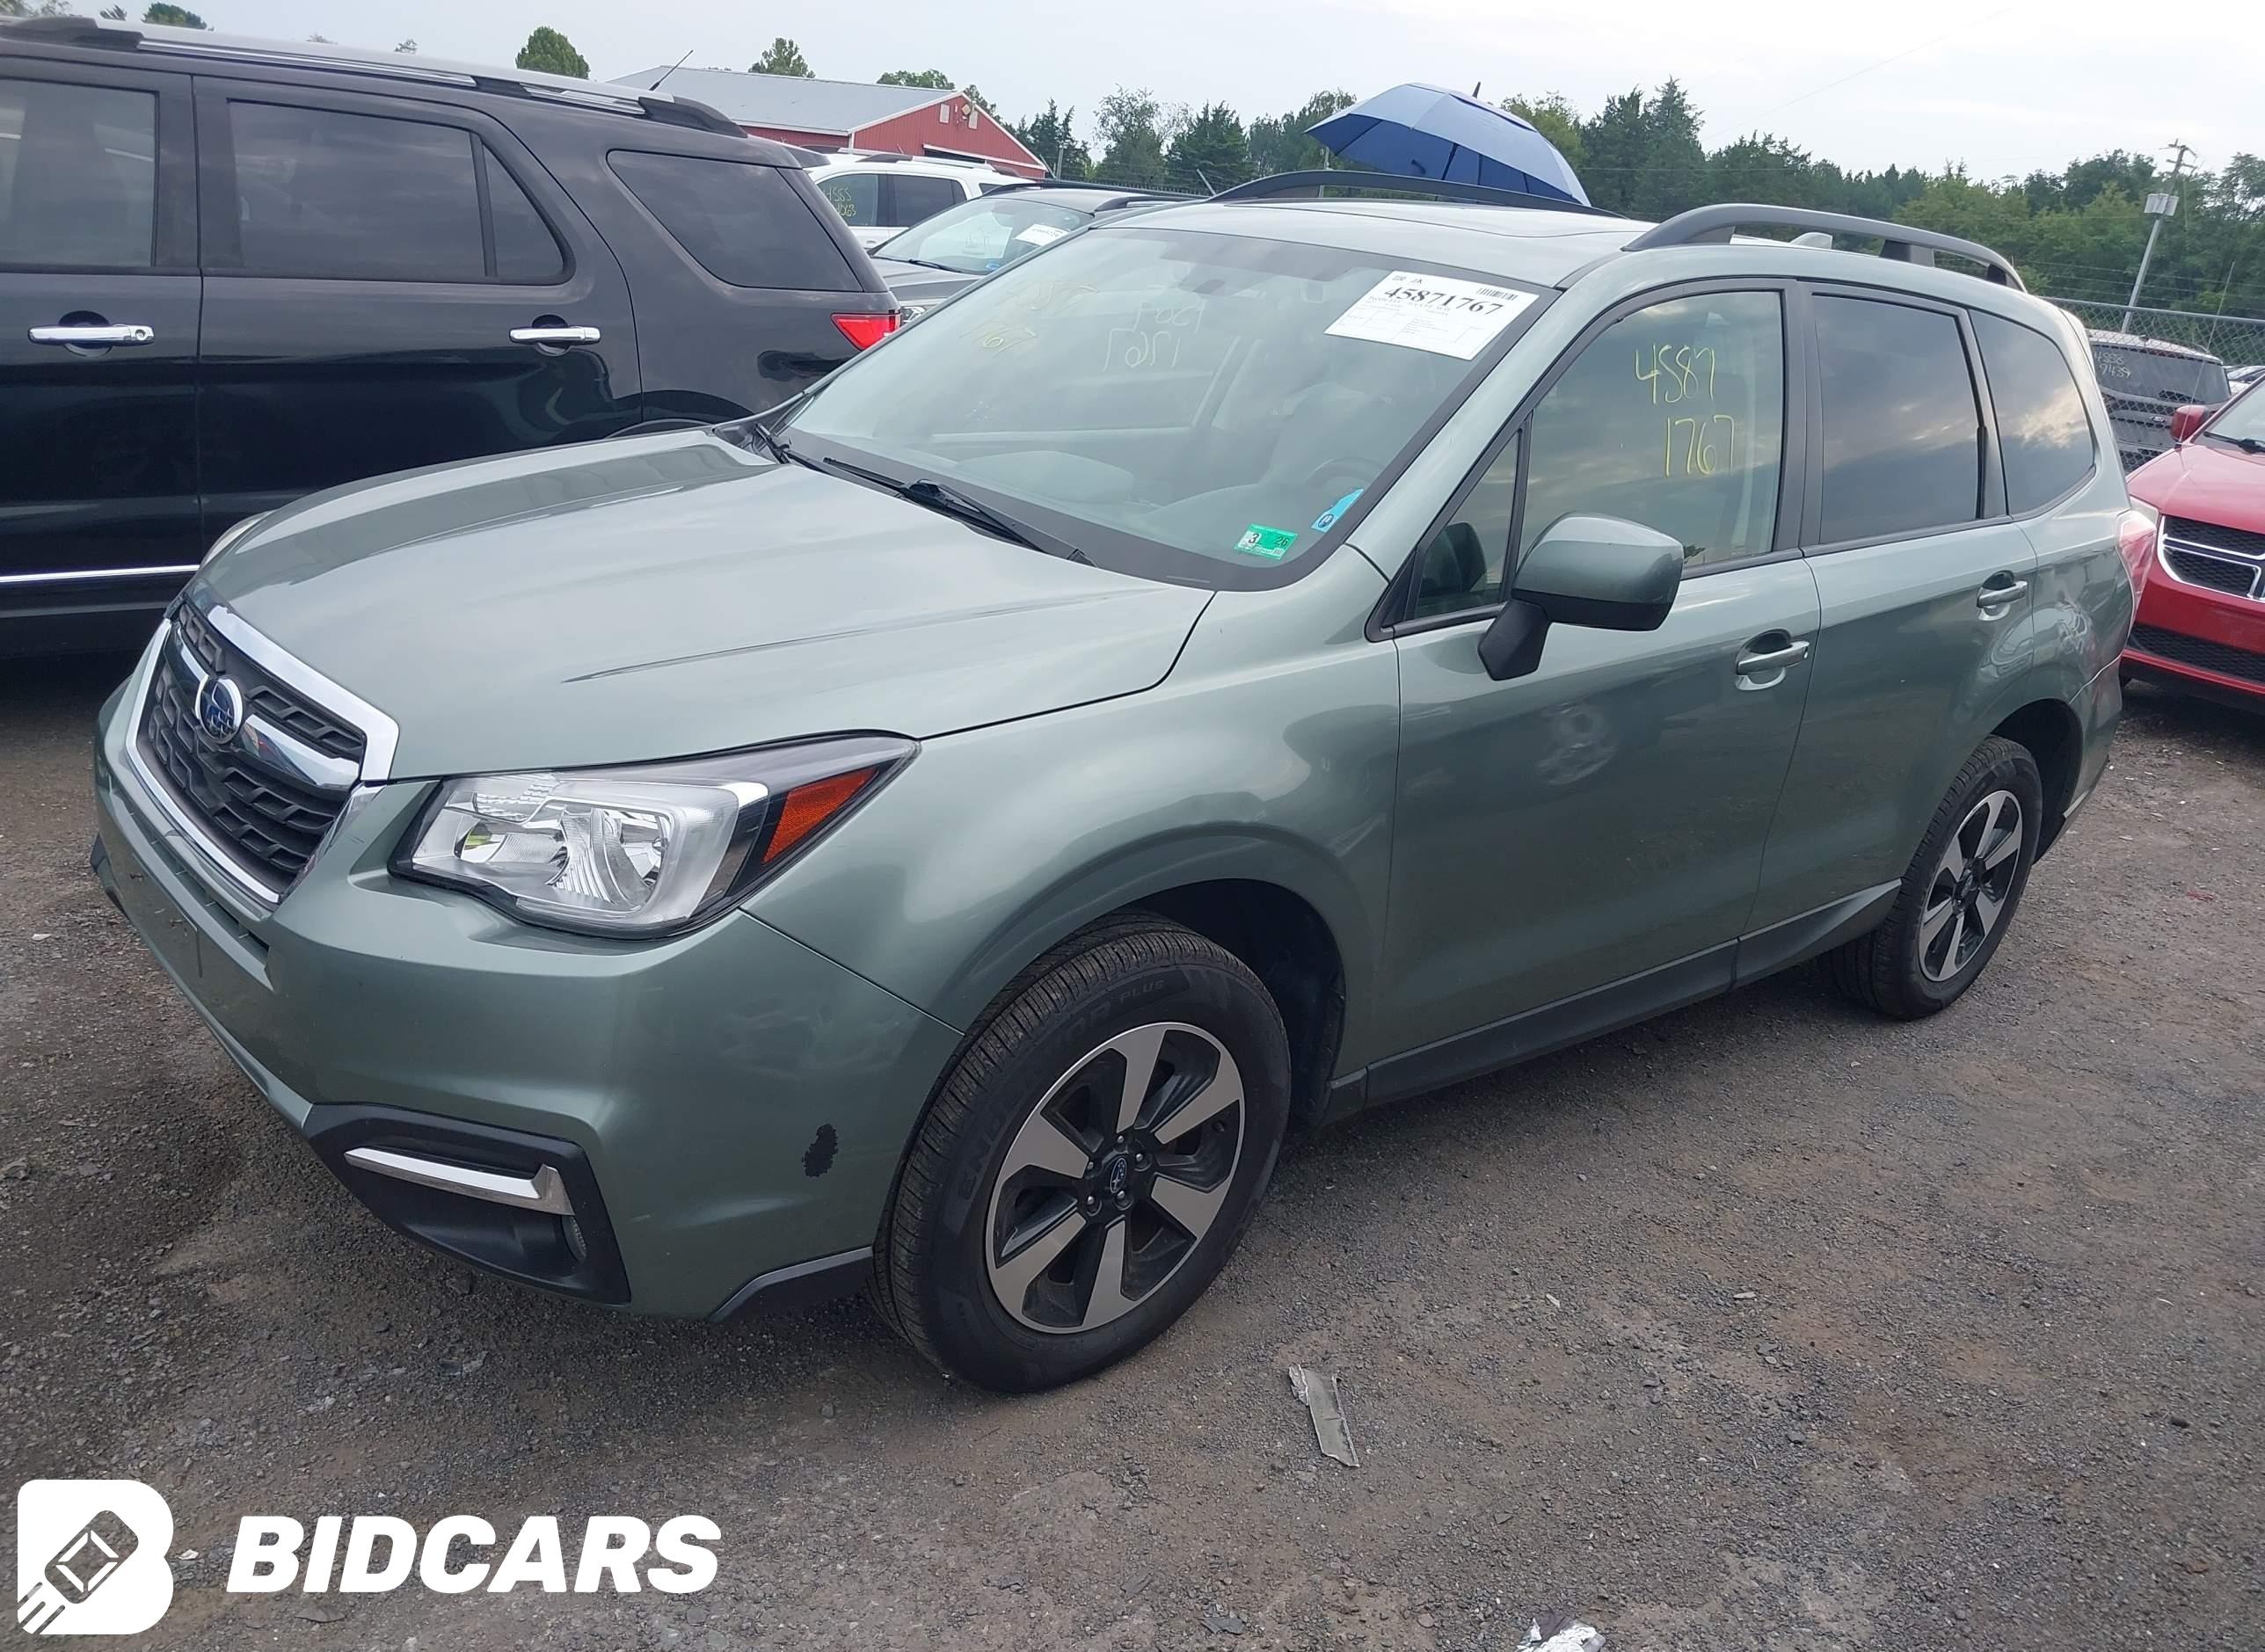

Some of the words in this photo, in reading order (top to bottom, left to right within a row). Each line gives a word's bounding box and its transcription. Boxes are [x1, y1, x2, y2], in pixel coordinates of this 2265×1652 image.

[1384, 287, 1504, 315] 45871767
[1635, 342, 1715, 405] 4587
[1665, 414, 1734, 477] 1767
[1248, 533, 1260, 544] 3
[1273, 535, 1291, 547] 26
[1119, 979, 1166, 1004] PLUS
